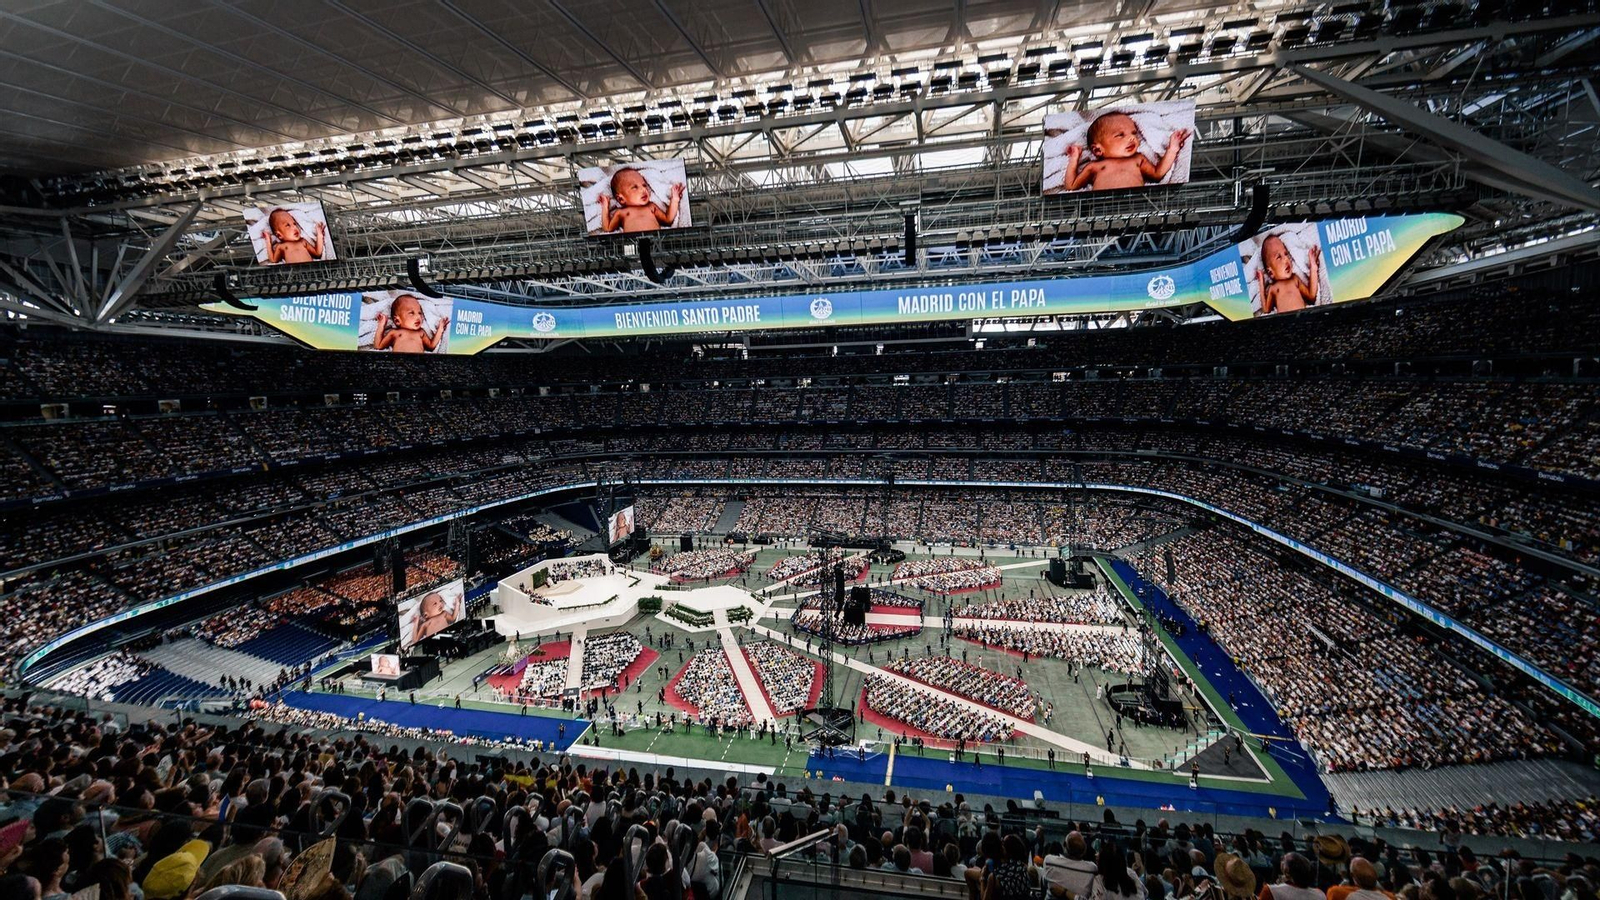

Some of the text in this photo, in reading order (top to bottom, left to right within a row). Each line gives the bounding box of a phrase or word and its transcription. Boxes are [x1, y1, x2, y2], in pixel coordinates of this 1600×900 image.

[1325, 218, 1368, 244] MADRID
[1330, 229, 1396, 267] CON EL PAPA
[898, 288, 1046, 314] MADRID CON EL PAPA
[280, 305, 351, 326] SANTO PADRE
[455, 310, 492, 337] MADRID CON EL PAPA
[615, 305, 761, 329] BIENVENIDO SANTO PADRE
